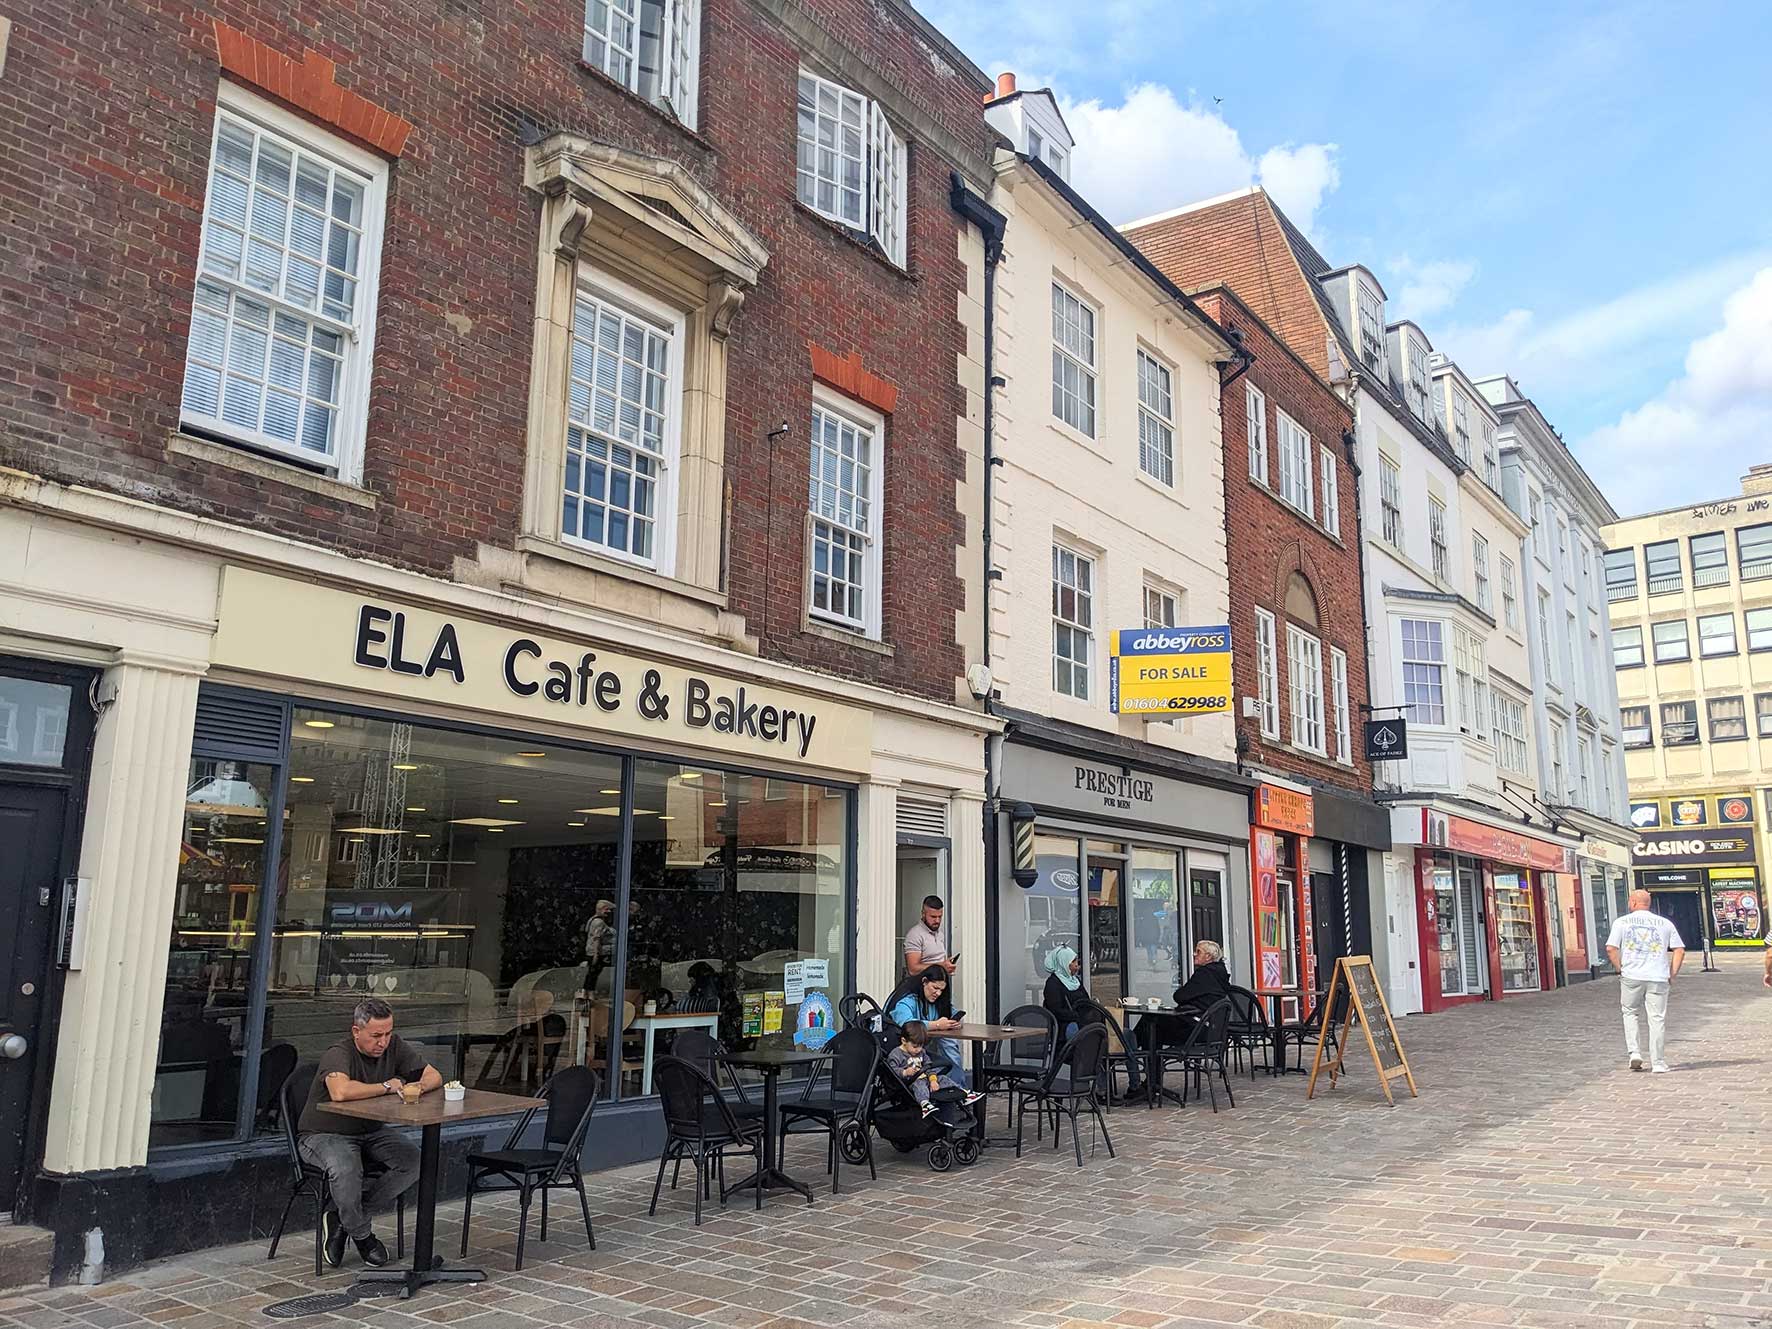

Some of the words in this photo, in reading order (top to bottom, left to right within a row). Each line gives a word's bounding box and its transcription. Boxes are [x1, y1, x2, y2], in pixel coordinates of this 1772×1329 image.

[1133, 633, 1225, 652] abbeyross
[354, 604, 465, 683] ELA
[502, 638, 622, 713] Cafe
[638, 668, 669, 721] &
[685, 677, 817, 758] Bakery
[1140, 668, 1168, 680] FOR
[1172, 666, 1208, 679] SALE
[1074, 766, 1153, 802] PRESTIGE
[1103, 797, 1116, 807] FOR
[1117, 799, 1131, 809] MEN
[1633, 840, 1705, 856] CASINO
[787, 968, 802, 976] RENT
